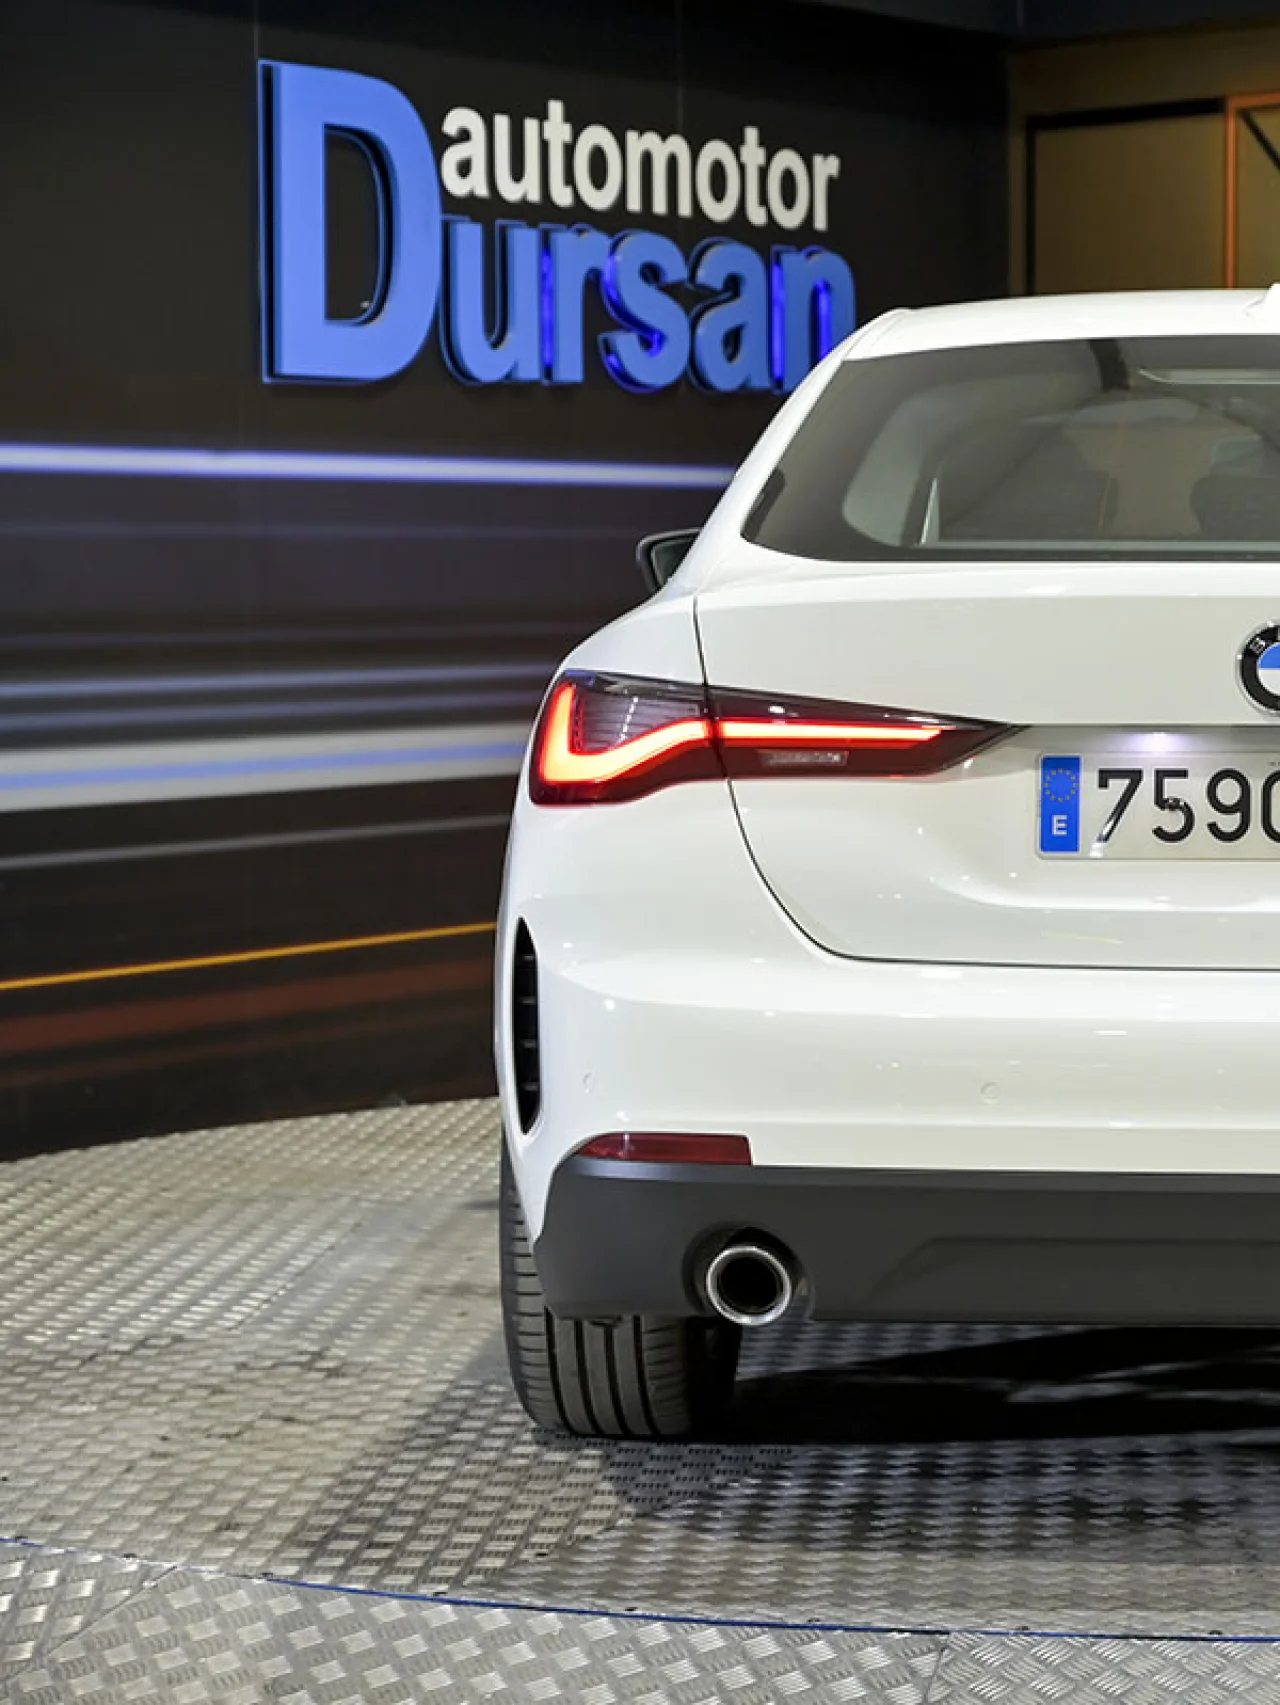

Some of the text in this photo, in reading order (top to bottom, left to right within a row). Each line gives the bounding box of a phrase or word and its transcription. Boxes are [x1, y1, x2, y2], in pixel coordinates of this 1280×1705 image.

[258, 58, 856, 394] Dursan
[441, 99, 840, 231] automotor
[1053, 814, 1067, 836] E
